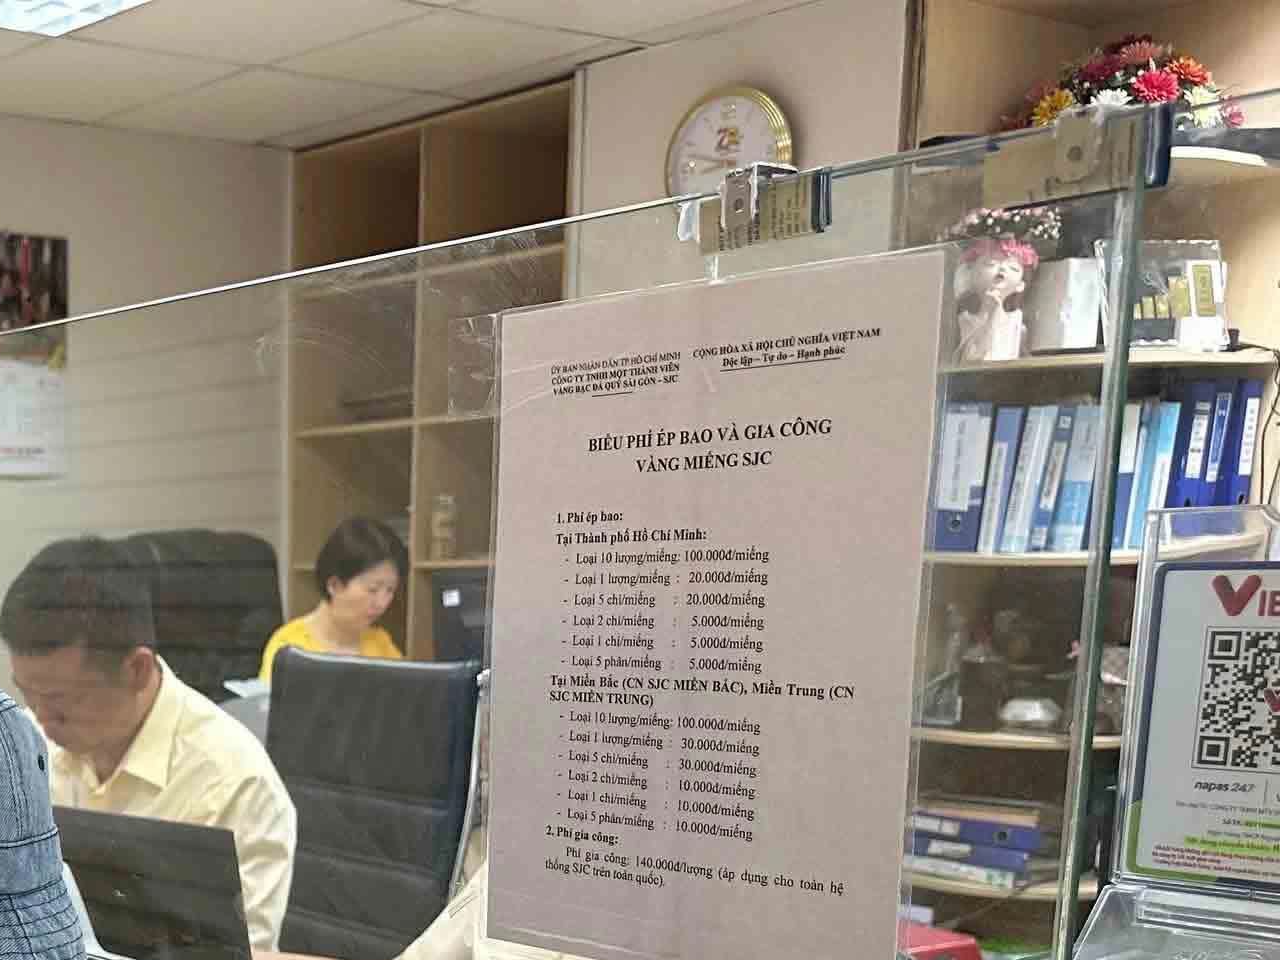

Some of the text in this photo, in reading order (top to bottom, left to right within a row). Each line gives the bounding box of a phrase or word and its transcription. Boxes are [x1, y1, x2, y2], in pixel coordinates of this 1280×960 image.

[832, 329, 855, 344] VIỆT
[857, 327, 881, 339] NAM
[659, 351, 681, 362] MINH
[776, 351, 788, 361] do
[797, 348, 821, 360] Hạnh
[574, 373, 585, 383] TY
[587, 369, 608, 381] TNHH
[663, 374, 679, 384] SJC
[627, 428, 652, 449] PHÍ
[656, 427, 676, 447] ÉP
[680, 427, 713, 445] BAO
[717, 421, 740, 442] VÀ
[744, 423, 775, 440] GIA
[779, 416, 833, 438] CÔNG
[635, 450, 773, 474] VÀNG MIẾNG SJC
[557, 511, 623, 525] 1. Phí ép bao:
[556, 527, 707, 546] Tại Thành phố Hồ Chí Minh:
[576, 552, 597, 565] Loại
[601, 551, 613, 563] 10
[684, 546, 770, 564] 100.000đ/miếng
[575, 573, 597, 587] Loại
[688, 567, 769, 586] 20.000đ/miếng
[574, 593, 595, 607] Loại
[598, 593, 605, 605] 5
[686, 589, 766, 609] 20.000đ/miếng
[573, 614, 594, 628] Loại
[597, 614, 604, 626] 2
[691, 612, 765, 631] 5.000đ/miếng
[572, 634, 594, 648] Loại
[690, 634, 764, 653] 5.000đ/miếng
[572, 655, 593, 668] Loại
[596, 655, 602, 667] 5
[688, 655, 763, 674] 5.000đ/miếng
[549, 688, 655, 706] SJC MIỀN TRUNG)
[551, 674, 567, 688] Tại
[569, 674, 596, 689] Miền
[599, 675, 619, 689] Bắc
[622, 677, 644, 692] (CN
[647, 678, 670, 691] SJC
[673, 678, 708, 693] MIỀN
[752, 680, 782, 696] Miền
[787, 683, 825, 700] Trung
[829, 685, 855, 700] (CN
[570, 710, 591, 725] Loại
[595, 711, 606, 724] 10
[676, 715, 761, 735] 100.000đ/miếng
[569, 730, 591, 744] Loại
[681, 737, 760, 757] 30.000đ/miếng
[568, 750, 590, 763] Loại
[592, 751, 599, 762] 5
[679, 758, 757, 778] 30.000đ/miếng
[568, 769, 589, 783] Loại
[591, 771, 598, 782] 2
[678, 779, 756, 799] 10.000đ/miếng
[1193, 781, 1257, 793] napas 247
[567, 789, 588, 802] Loại
[677, 799, 755, 820] 10.000đ/miếng
[567, 808, 588, 822] Loại
[590, 811, 597, 822] 5
[675, 820, 753, 841] 10.000đ/miếng
[545, 825, 619, 846] 2. Phí gia công:
[545, 858, 571, 874] thống
[572, 862, 591, 875] SJC
[592, 864, 612, 878] trên
[613, 868, 634, 882] toàn
[566, 846, 845, 897] Phí gia công: 140.000đ/lượng (áp dụng cho toàn hệ
